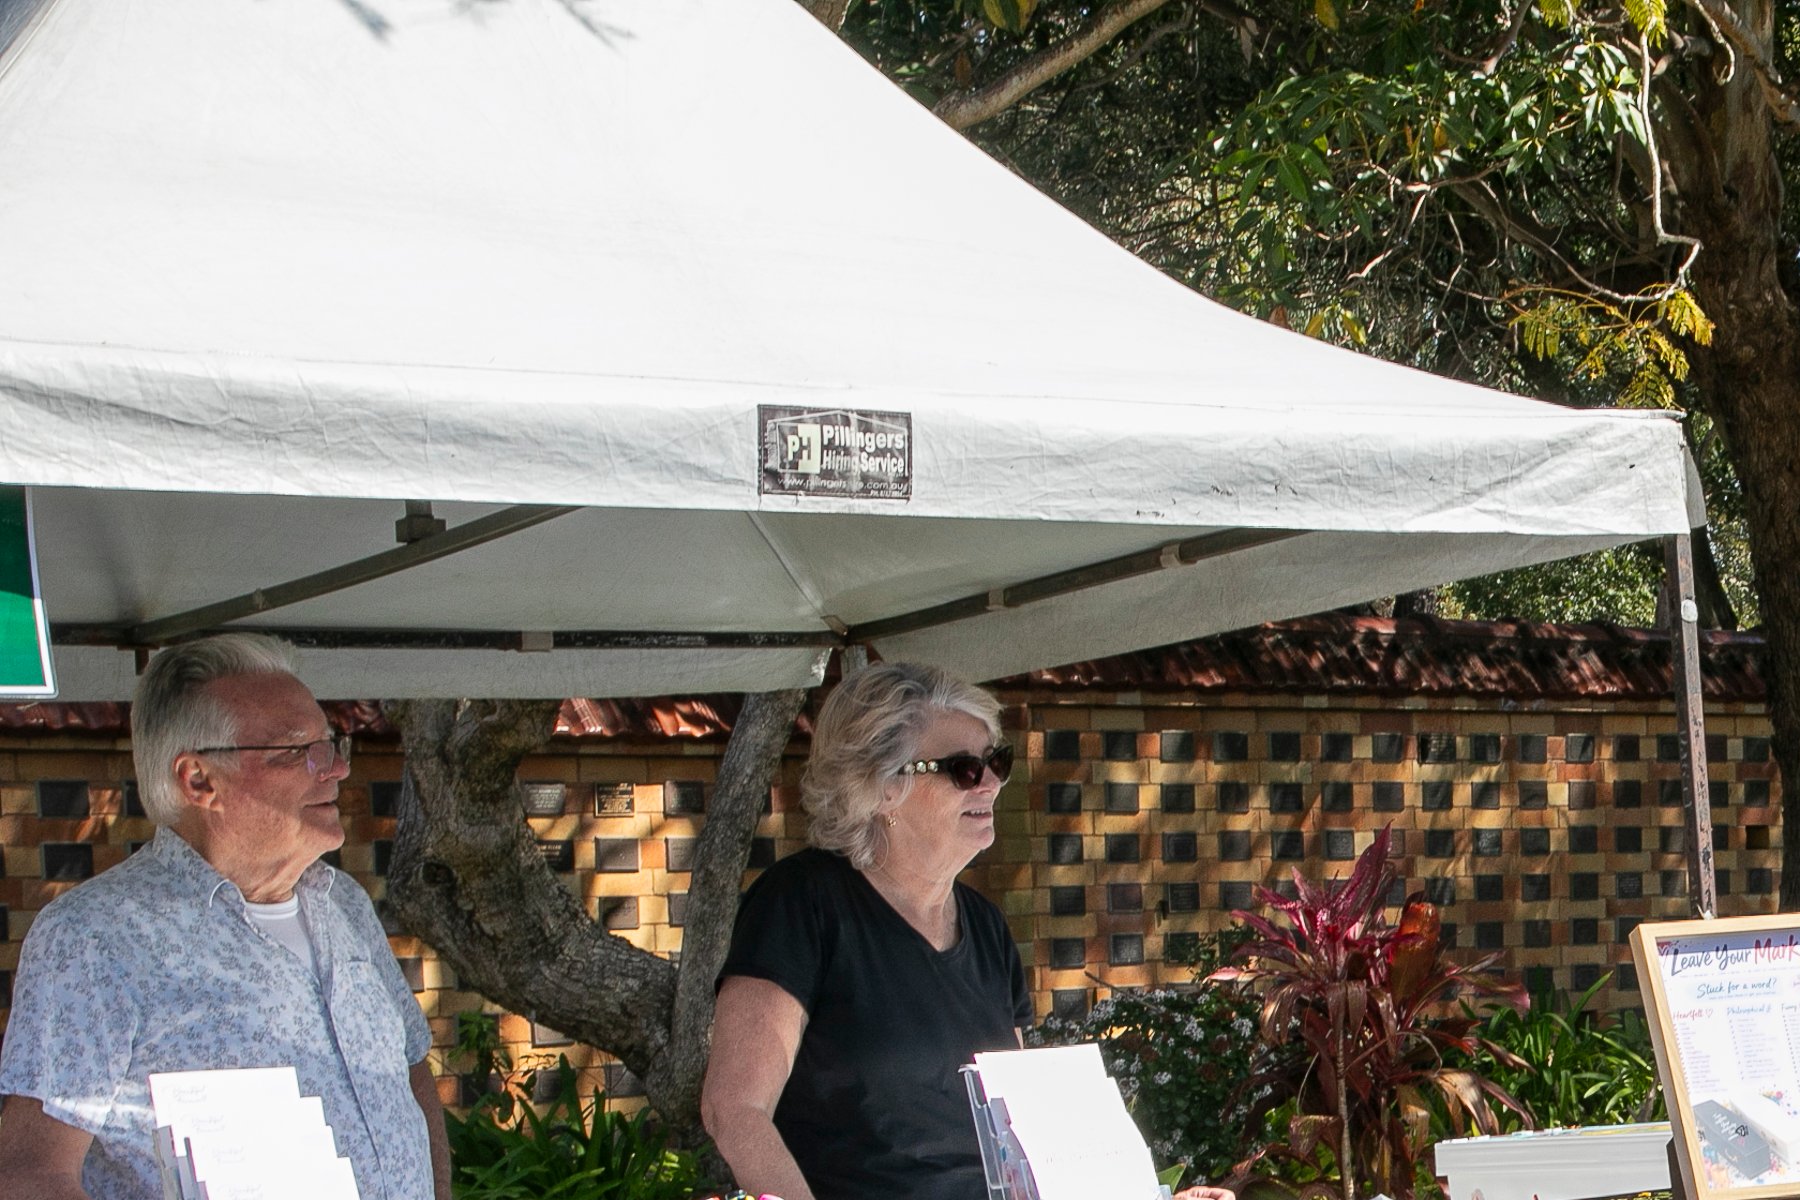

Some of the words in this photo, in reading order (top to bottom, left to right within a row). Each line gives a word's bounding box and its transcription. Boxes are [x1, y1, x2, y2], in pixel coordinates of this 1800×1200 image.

[822, 424, 904, 453] Pillingers
[822, 450, 859, 475] Hiring
[861, 453, 905, 473] Service
[1671, 948, 1713, 976] Leave
[1716, 944, 1752, 971] Your
[1697, 981, 1724, 999] Stuck
[1727, 982, 1740, 995] for
[1751, 977, 1778, 990] word?
